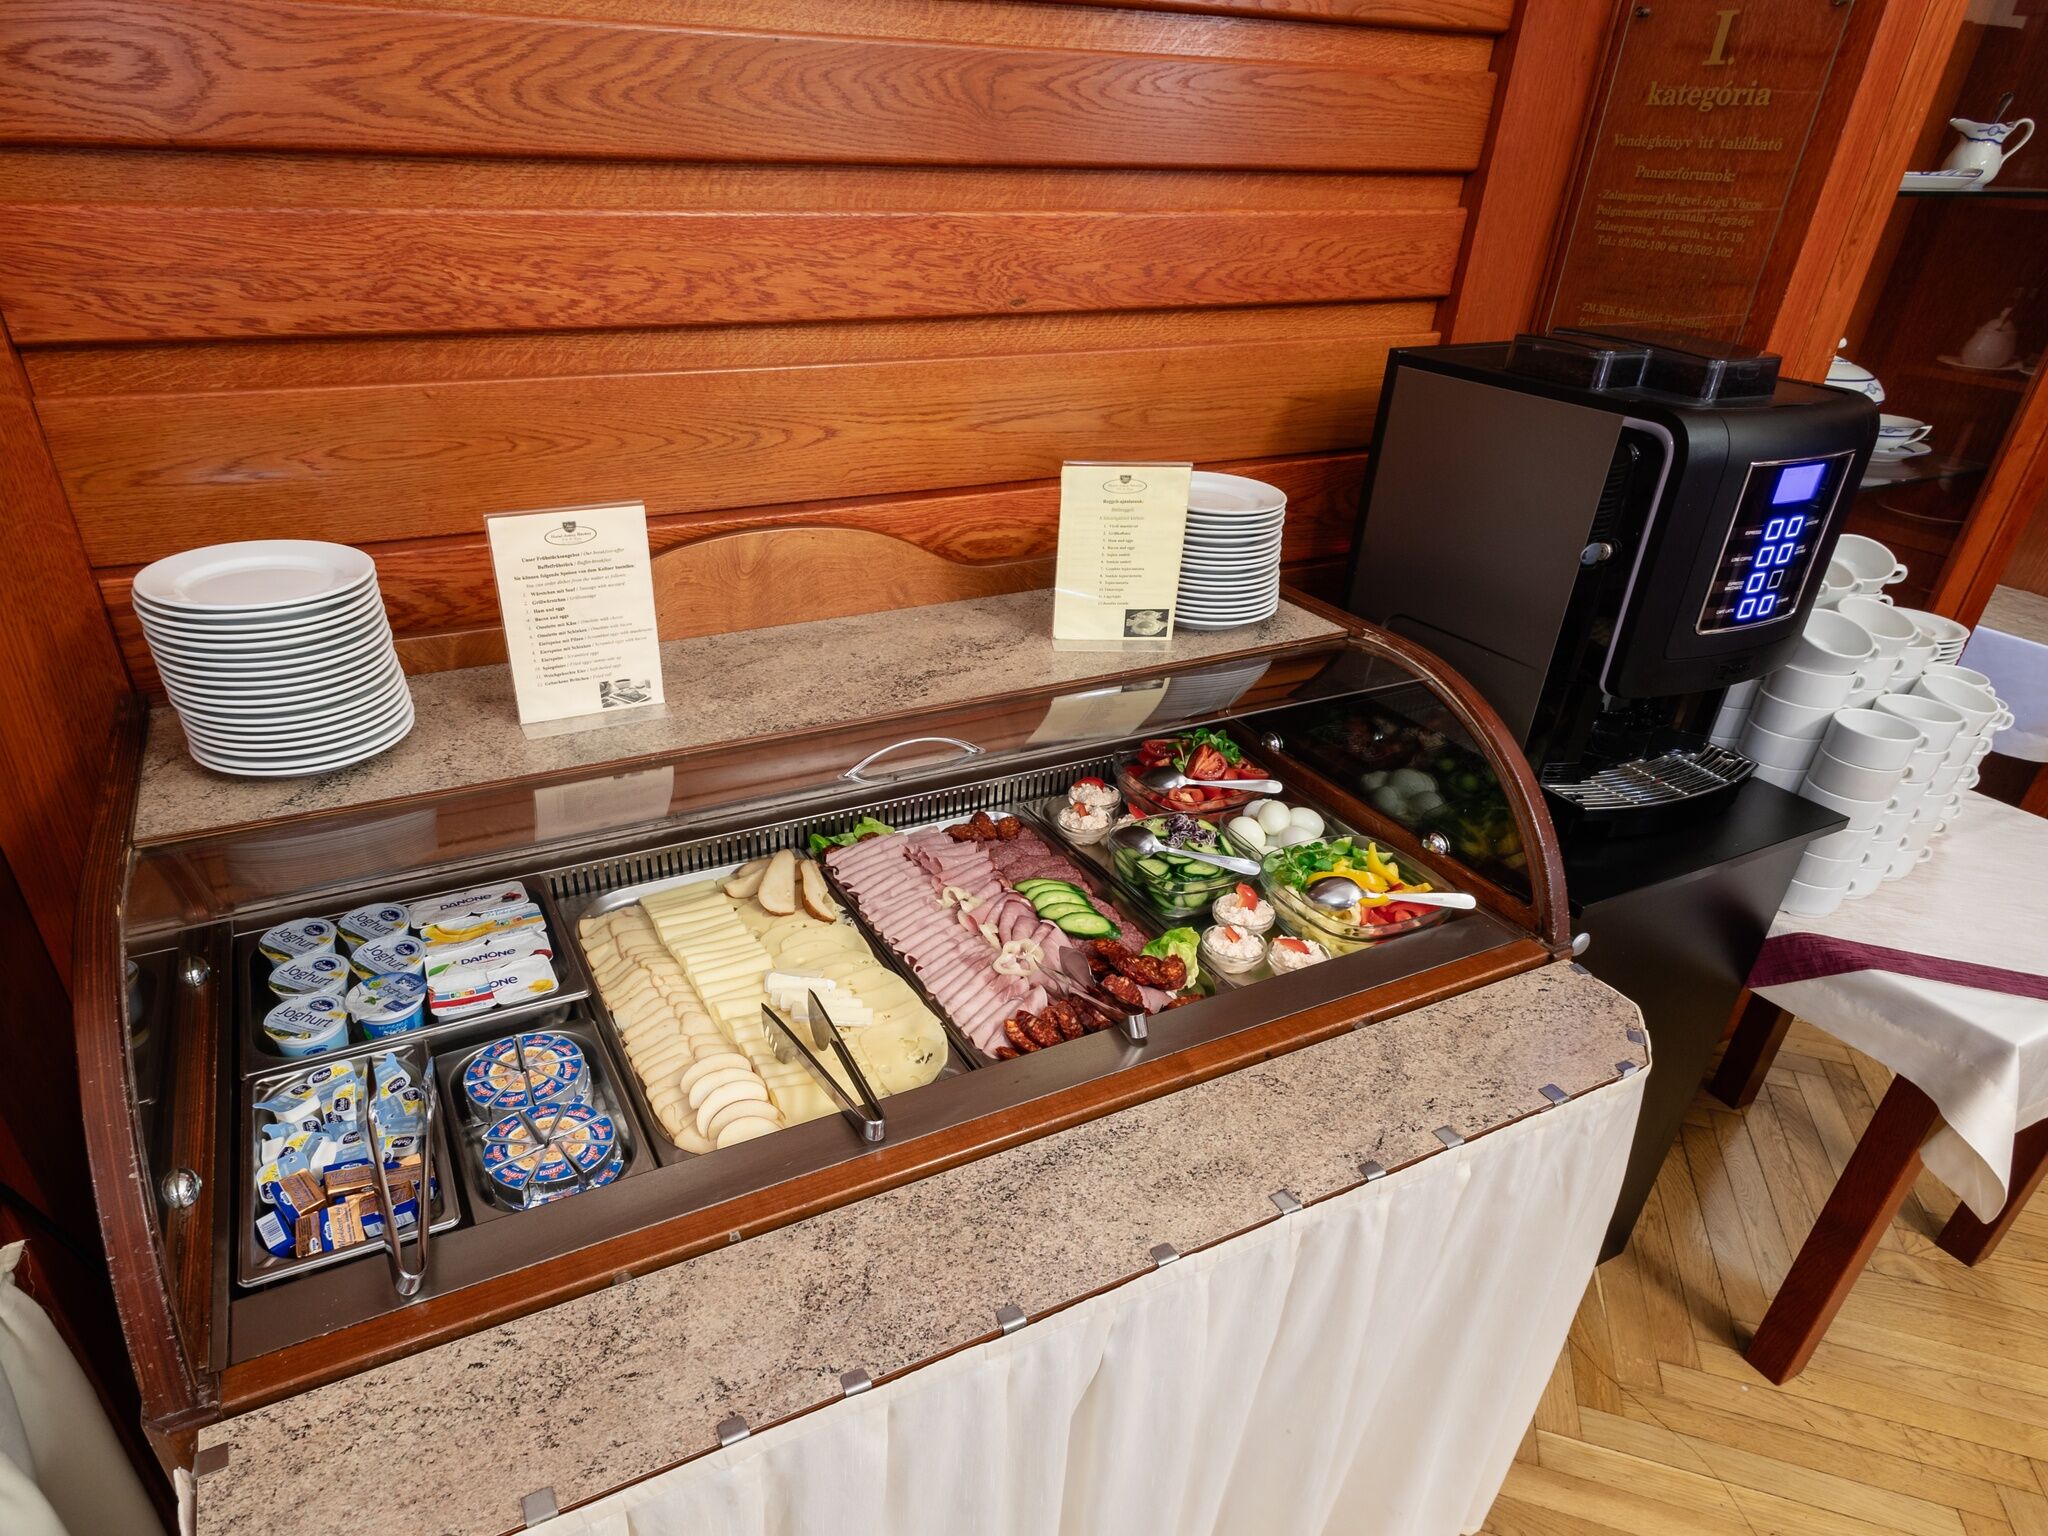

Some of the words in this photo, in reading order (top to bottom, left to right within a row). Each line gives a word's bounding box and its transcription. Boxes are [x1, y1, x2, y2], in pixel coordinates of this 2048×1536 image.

[1702, 8, 1740, 66] I.
[1645, 80, 1772, 112] kategória
[1614, 133, 1693, 150] Vendégkönyv
[1698, 136, 1714, 149] itt
[1720, 136, 1782, 151] található
[1635, 165, 1737, 182] Panaszfórumok:
[440, 894, 492, 911] DANONE
[352, 912, 395, 935] Joghurt
[275, 927, 320, 950] Joghurt
[367, 944, 409, 971] Joghurt
[461, 948, 517, 966] DANONE
[283, 964, 335, 986] Joghurt
[490, 976, 518, 989] ONE
[277, 1006, 334, 1028] Joghurt
